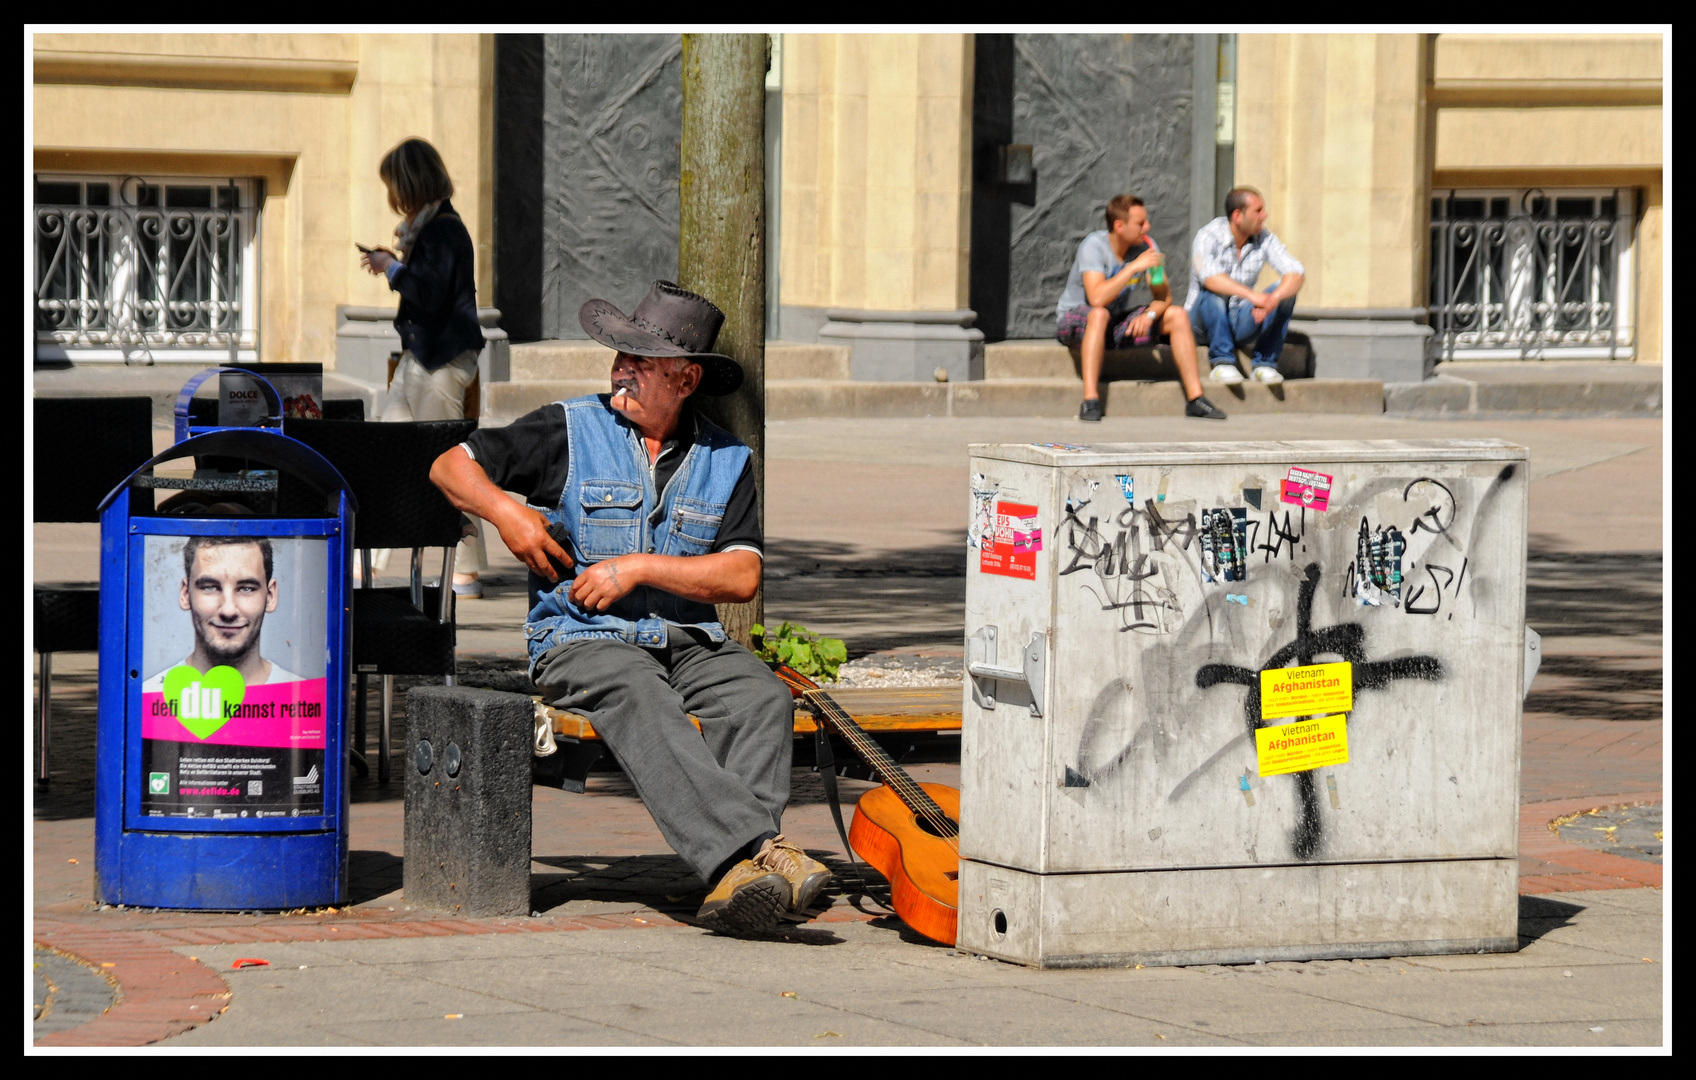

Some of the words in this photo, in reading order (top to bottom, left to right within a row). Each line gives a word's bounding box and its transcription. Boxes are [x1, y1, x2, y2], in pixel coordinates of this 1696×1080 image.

[229, 391, 258, 399] DOLCE
[1287, 669, 1324, 679] Vietnam
[1273, 678, 1340, 693] Afghanistan
[152, 699, 178, 717] defi
[180, 681, 221, 719] du
[224, 700, 275, 718] kannst
[280, 701, 321, 718] retten
[1282, 723, 1320, 736] Vietnam
[1268, 731, 1335, 750] Afghanistan
[179, 787, 240, 795] www.defidu.de
